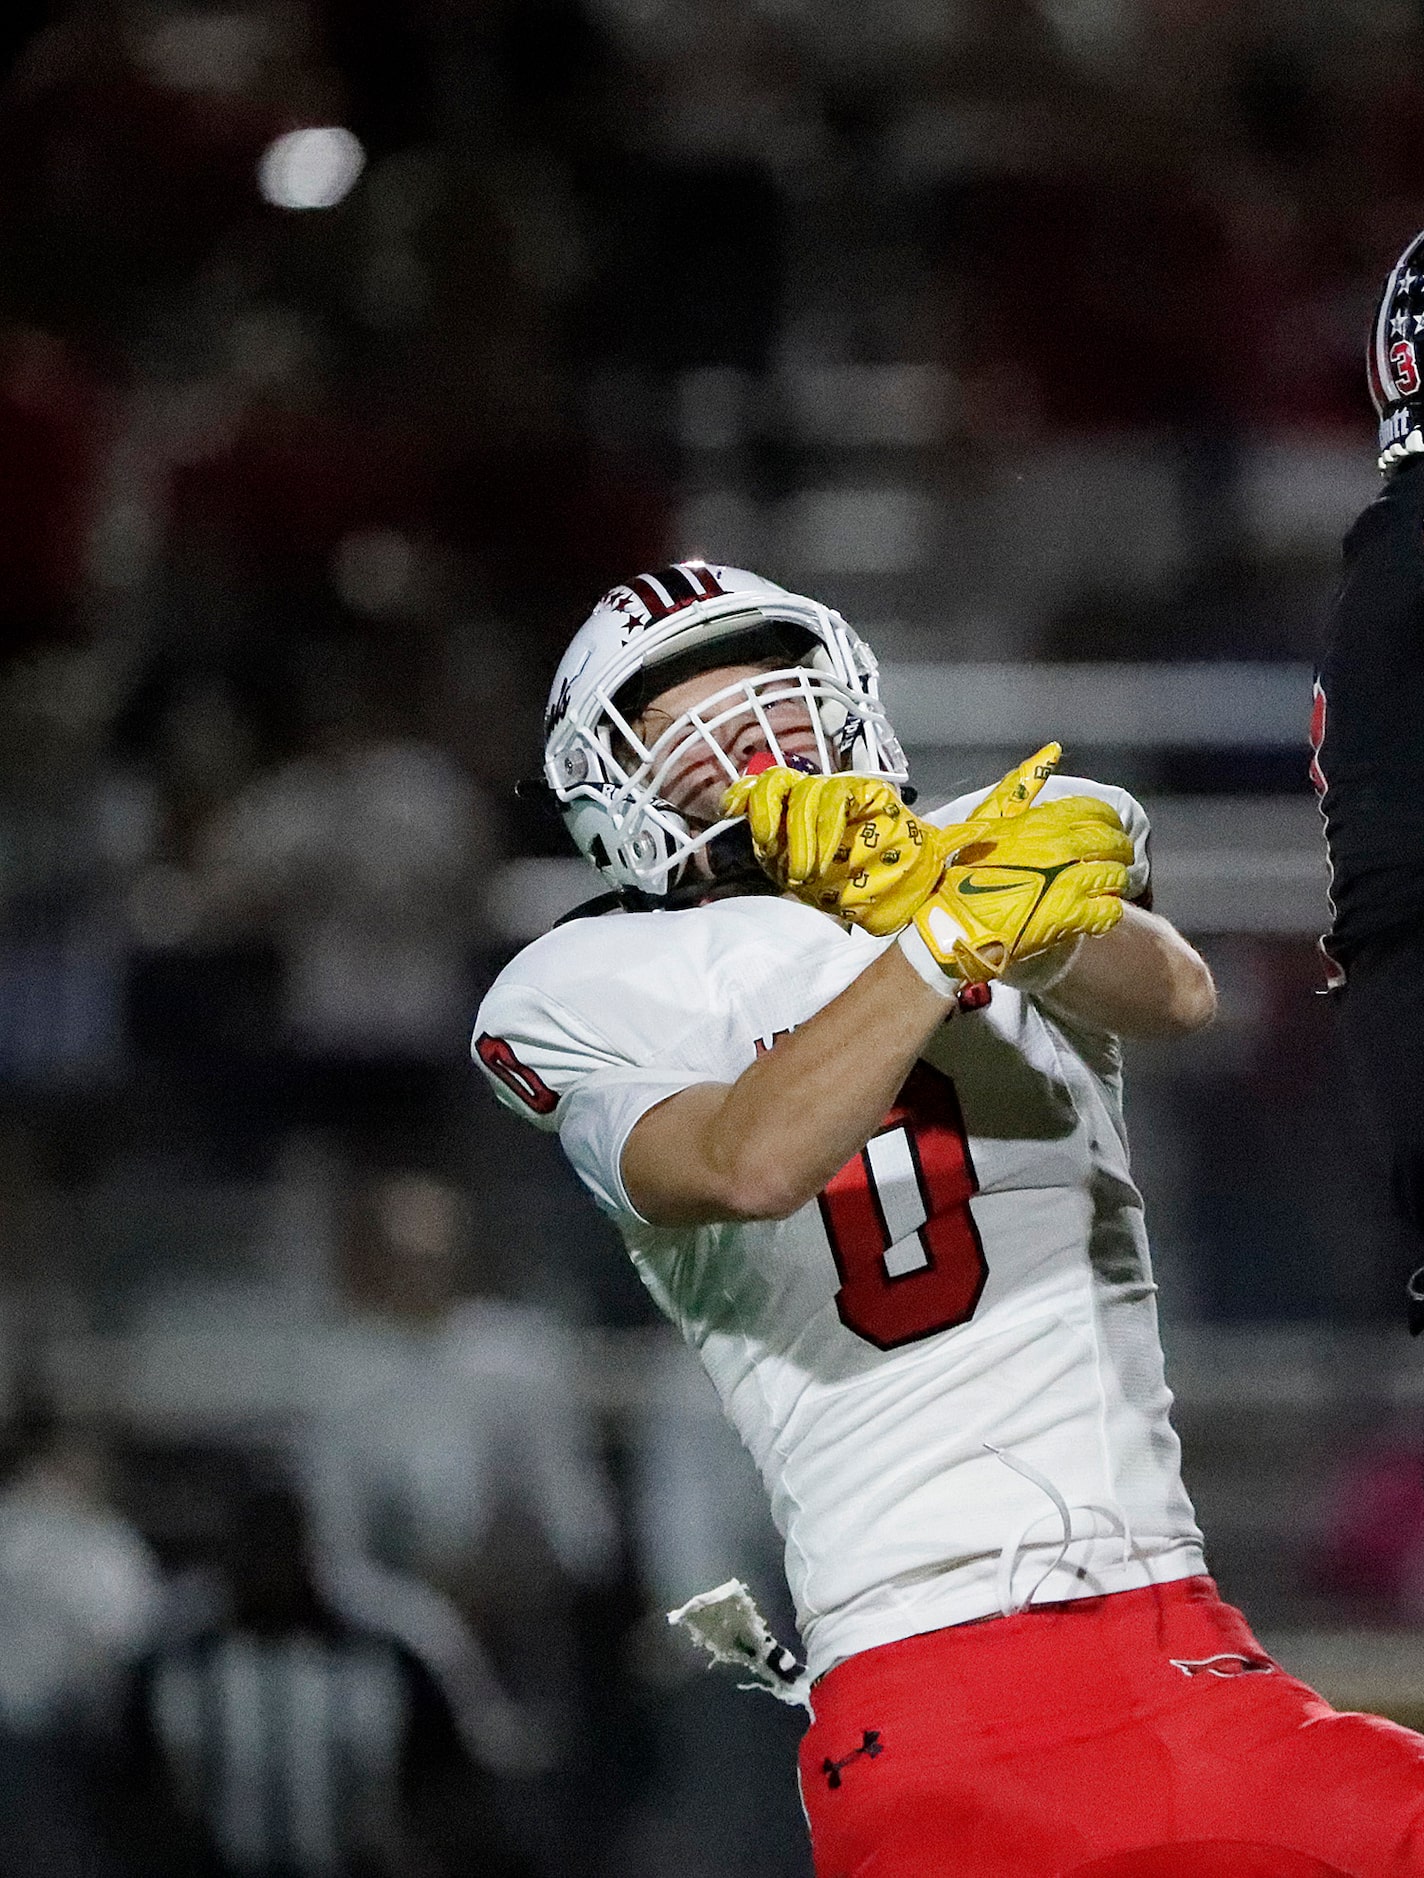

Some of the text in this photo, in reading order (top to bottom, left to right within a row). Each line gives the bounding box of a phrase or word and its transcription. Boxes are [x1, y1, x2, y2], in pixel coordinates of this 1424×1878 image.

[1390, 339, 1421, 396] 3
[860, 822, 880, 848] BU
[475, 1033, 560, 1114] 0
[818, 1060, 989, 1351] 0
